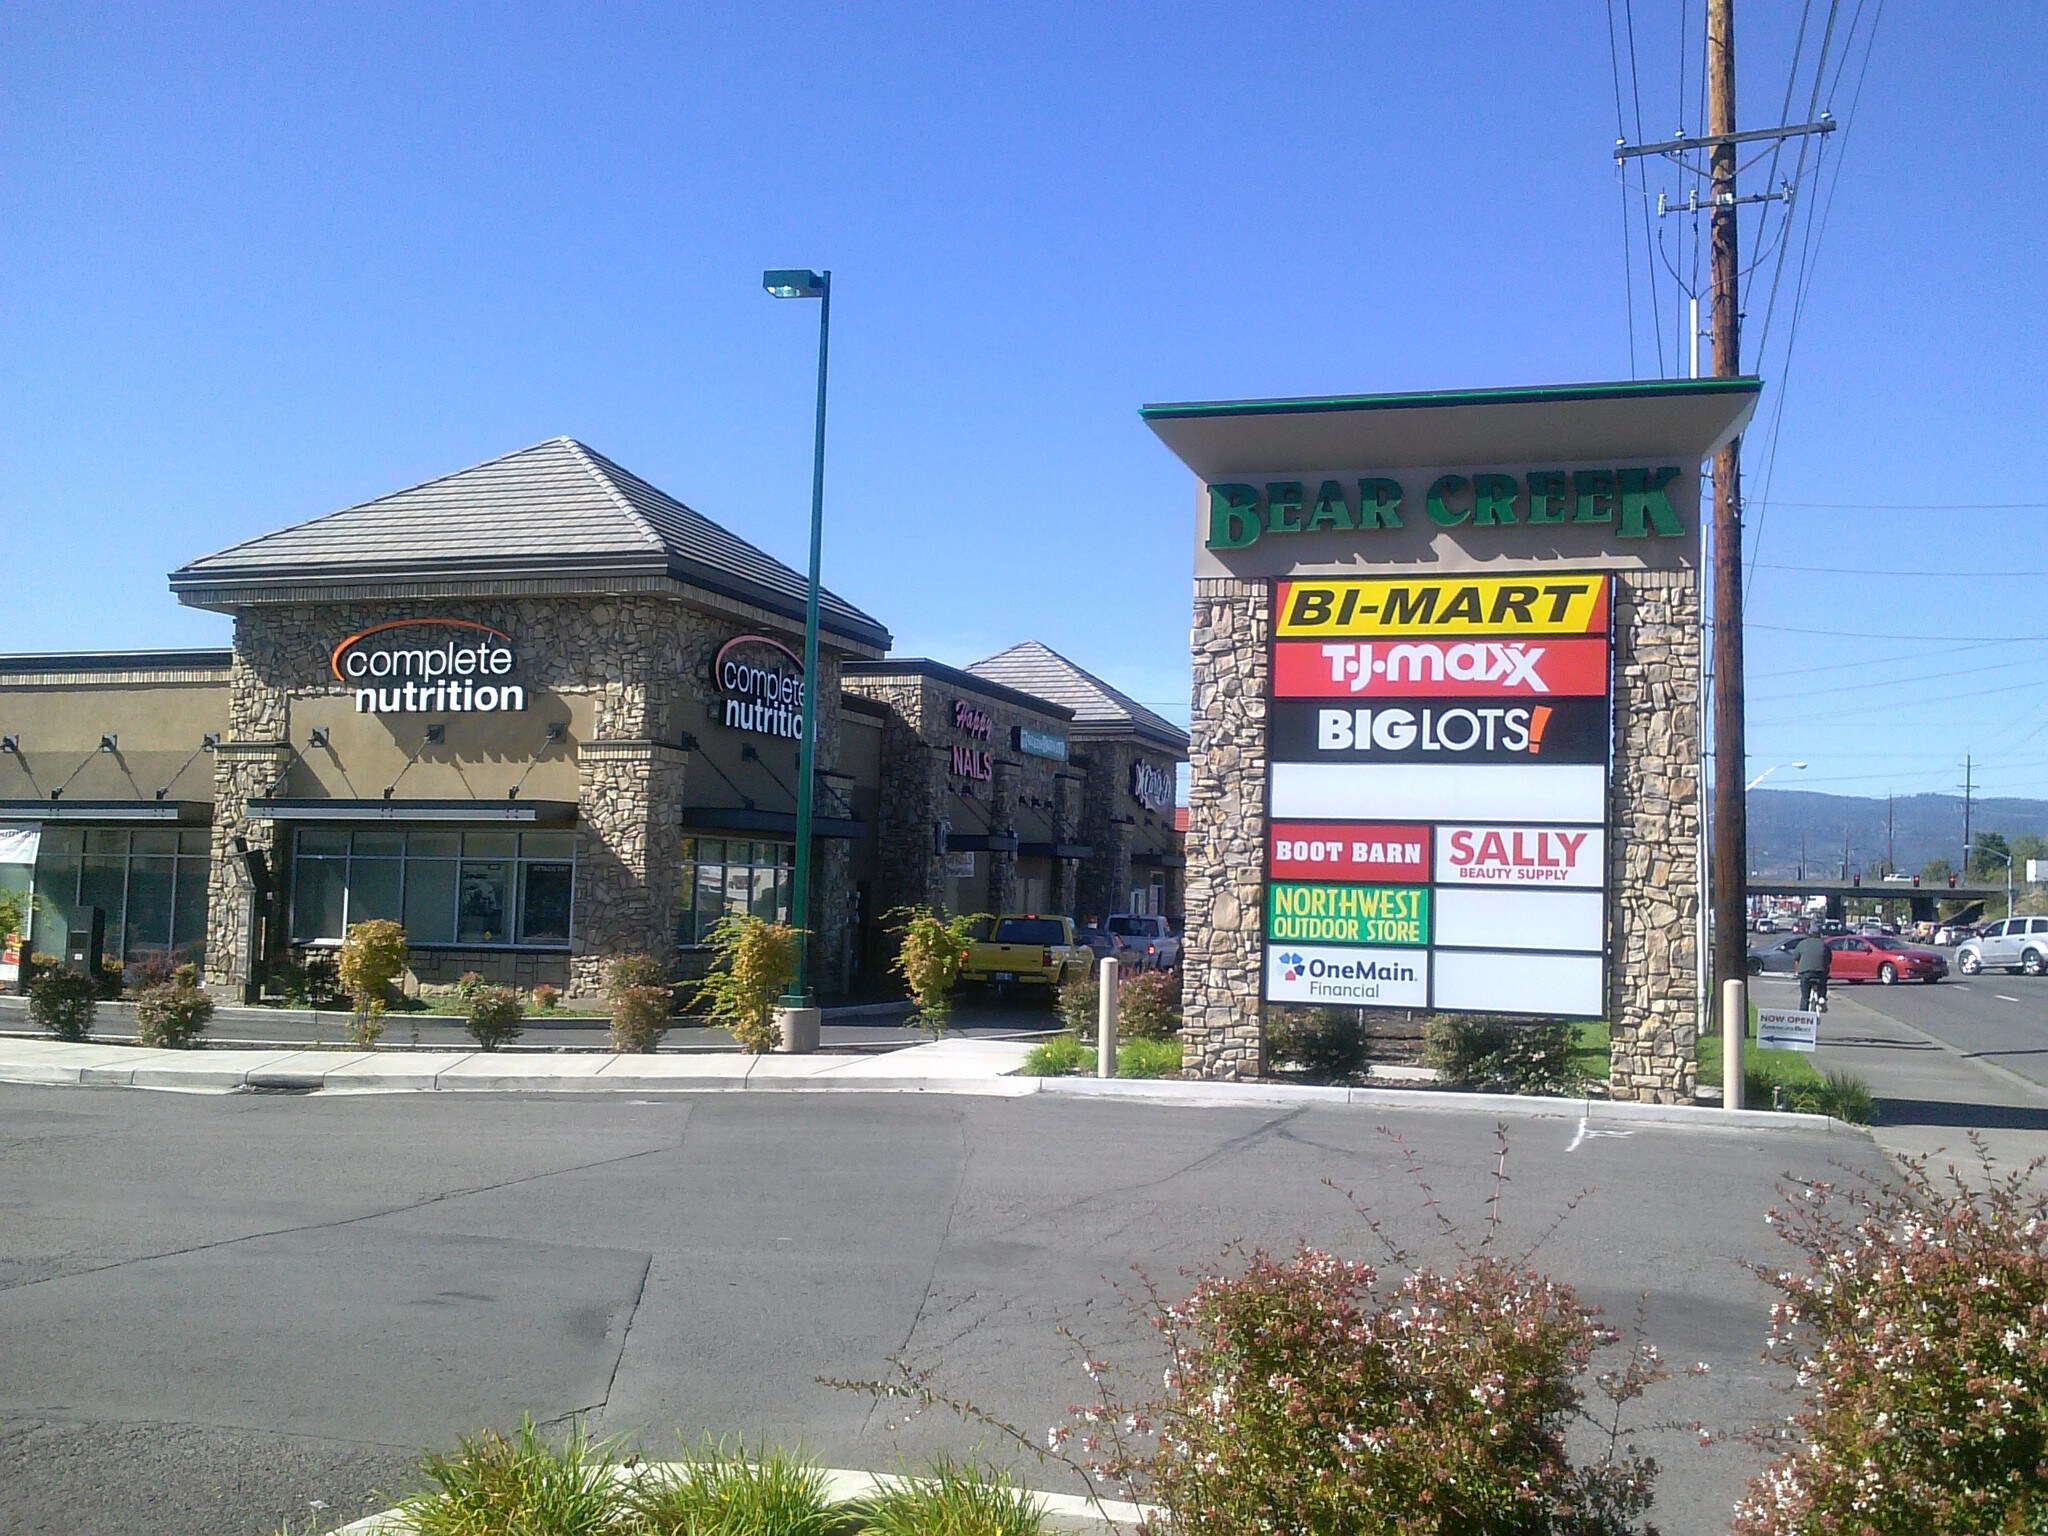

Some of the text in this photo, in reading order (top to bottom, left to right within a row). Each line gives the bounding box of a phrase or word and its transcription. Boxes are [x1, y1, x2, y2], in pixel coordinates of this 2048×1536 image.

[1205, 466, 1686, 550] BEAR CREEK
[1287, 584, 1589, 626] BI-MART
[346, 641, 512, 683] complete
[355, 679, 524, 713] nutrition
[955, 699, 992, 740] Happy
[952, 745, 992, 781] NAILS
[1275, 840, 1422, 865] BOOT BARN
[1448, 829, 1589, 868] SALLY
[1459, 867, 1569, 881] BEAUTY SUPPLY
[1274, 887, 1422, 920] NORTHWEST
[1273, 916, 1420, 943] OUTDOOR STORE
[1309, 958, 1415, 983] OneMain
[1310, 981, 1380, 998] Financial
[1760, 1014, 1814, 1025] NOW OPEN
